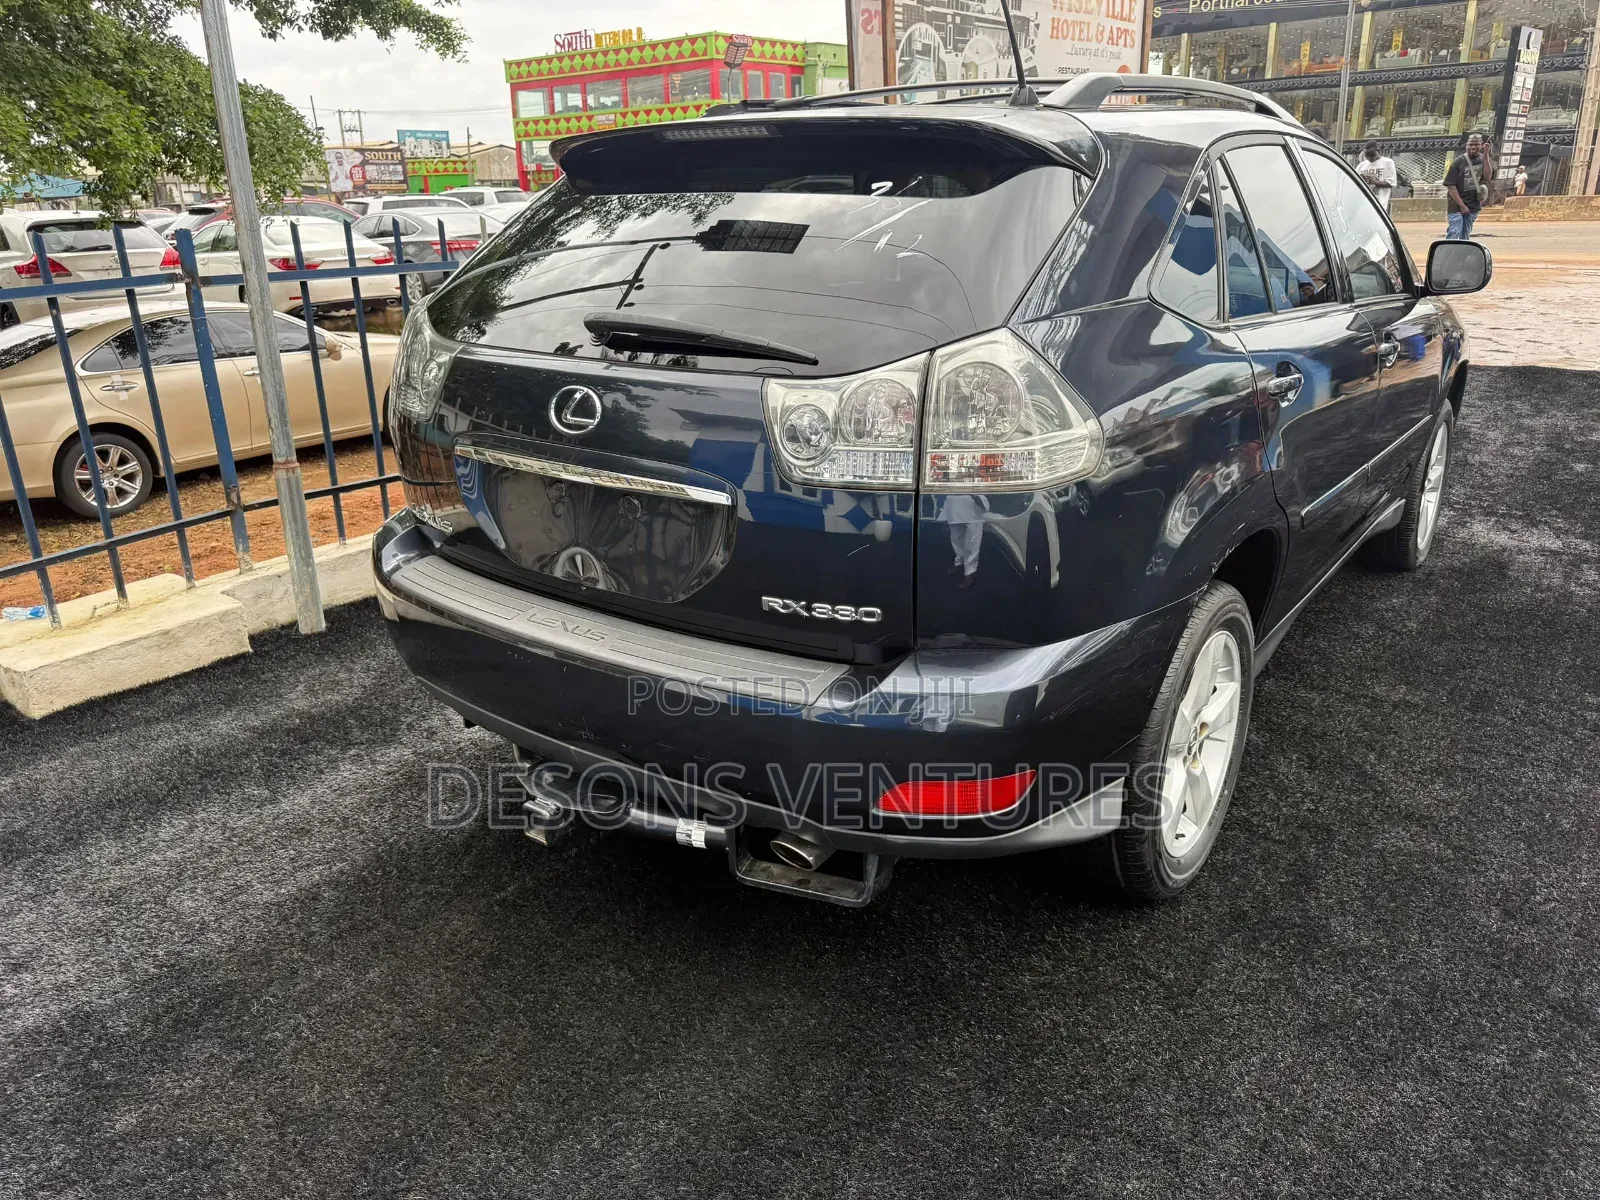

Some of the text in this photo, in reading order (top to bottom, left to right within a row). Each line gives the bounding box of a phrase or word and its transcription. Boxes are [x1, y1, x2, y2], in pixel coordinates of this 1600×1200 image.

[554, 29, 592, 54] South
[1049, 17, 1136, 48] HOTEL & APTS
[365, 152, 401, 160] SOUTH
[526, 612, 609, 642] LEXUS
